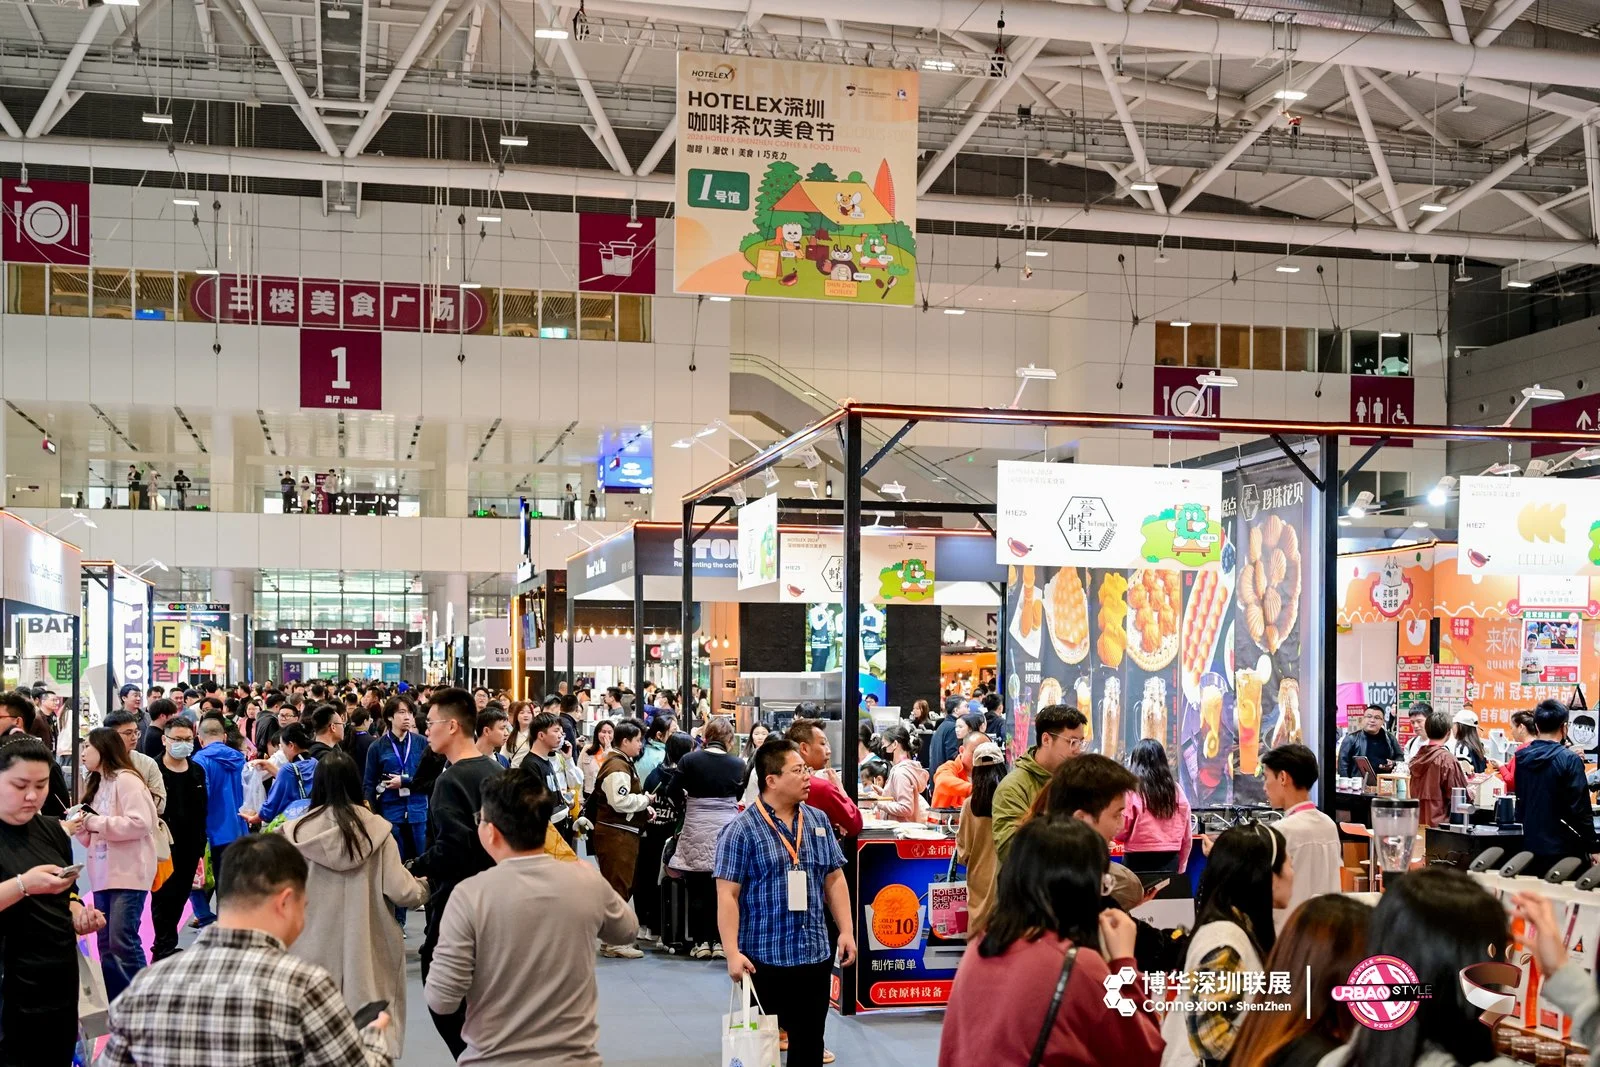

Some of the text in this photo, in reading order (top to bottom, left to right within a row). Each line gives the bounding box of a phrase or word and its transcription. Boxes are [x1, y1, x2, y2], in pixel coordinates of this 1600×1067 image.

[692, 69, 733, 80] HOTELEX
[688, 91, 825, 119] HOTELEX深圳
[688, 112, 835, 142] 咖啡茶饮美食节
[687, 145, 703, 154] 咖啡
[738, 148, 754, 158] 美食
[763, 150, 787, 160] 巧克力
[737, 138, 774, 146] SHENZHEN
[775, 141, 801, 149] COFFEE
[832, 145, 861, 154] FESTIVAL
[331, 346, 351, 390] 1
[344, 396, 358, 405] Hall
[1262, 482, 1304, 511] 珍珠花贝
[1006, 509, 1027, 517] H1E25
[933, 887, 965, 896] HOTELEX
[933, 895, 966, 903] SHENZHE
[933, 902, 949, 910] 2025
[895, 918, 914, 935] 10
[871, 959, 917, 971] 制作简单
